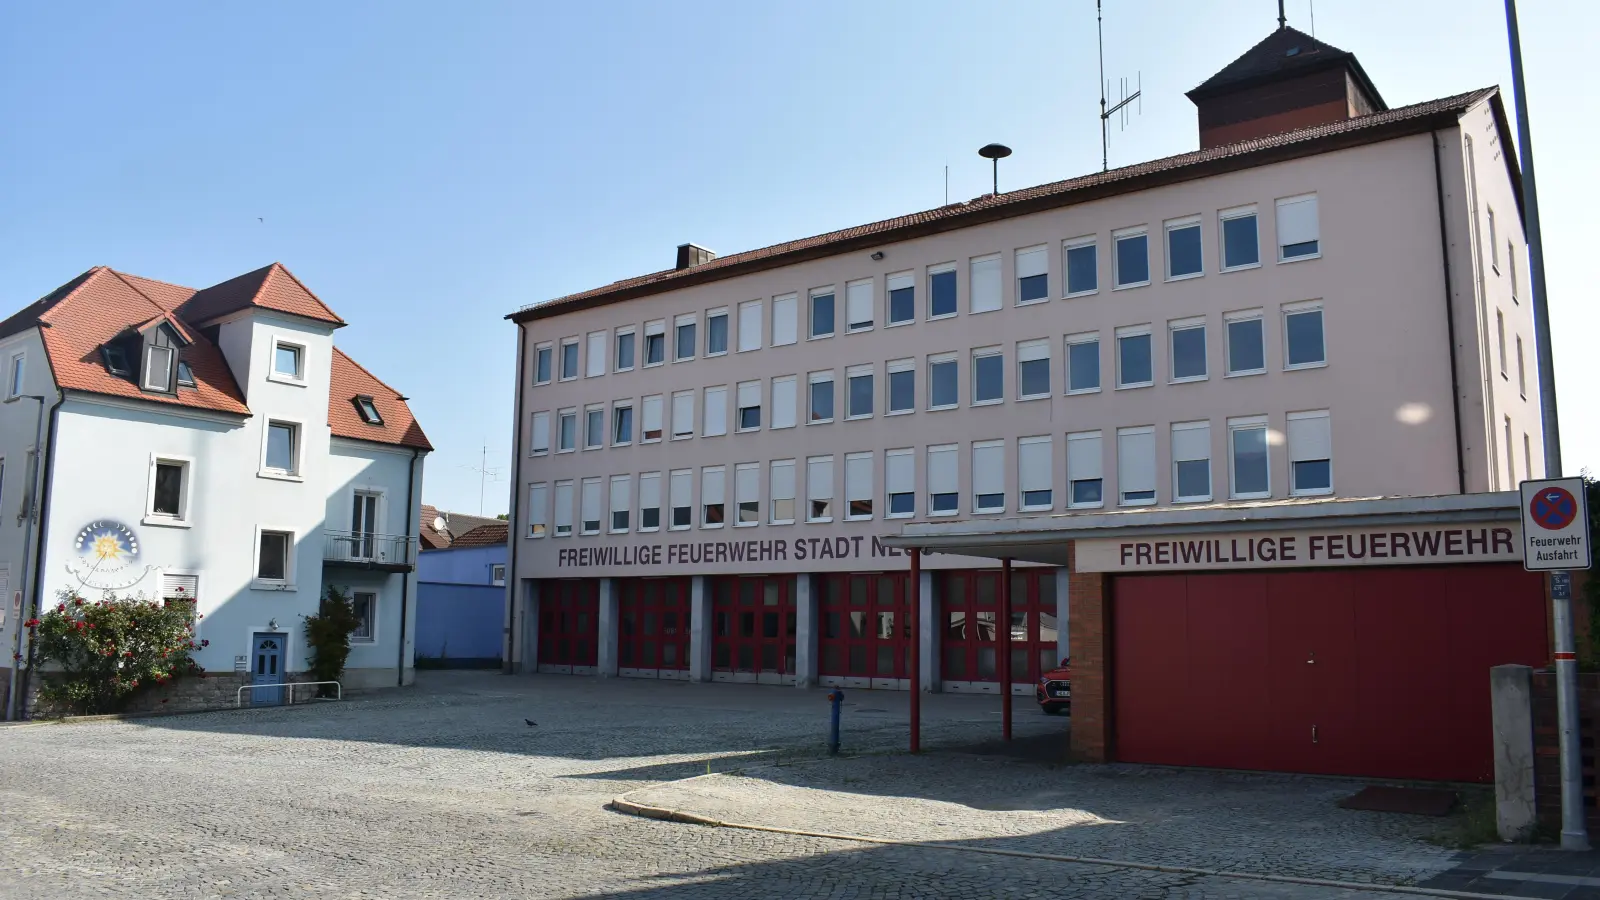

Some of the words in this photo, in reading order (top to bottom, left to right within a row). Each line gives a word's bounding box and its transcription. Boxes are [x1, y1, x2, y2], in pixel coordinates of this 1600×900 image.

[558, 545, 662, 568] FREIWILLIGE
[667, 540, 788, 565] FEUERWEHR
[793, 535, 864, 561] STADT
[1119, 536, 1297, 566] FREIWILLIGE
[1308, 527, 1515, 561] FEUERWEHR
[1530, 534, 1582, 547] Feuerwehr
[1536, 549, 1578, 562] Ausfahrt
